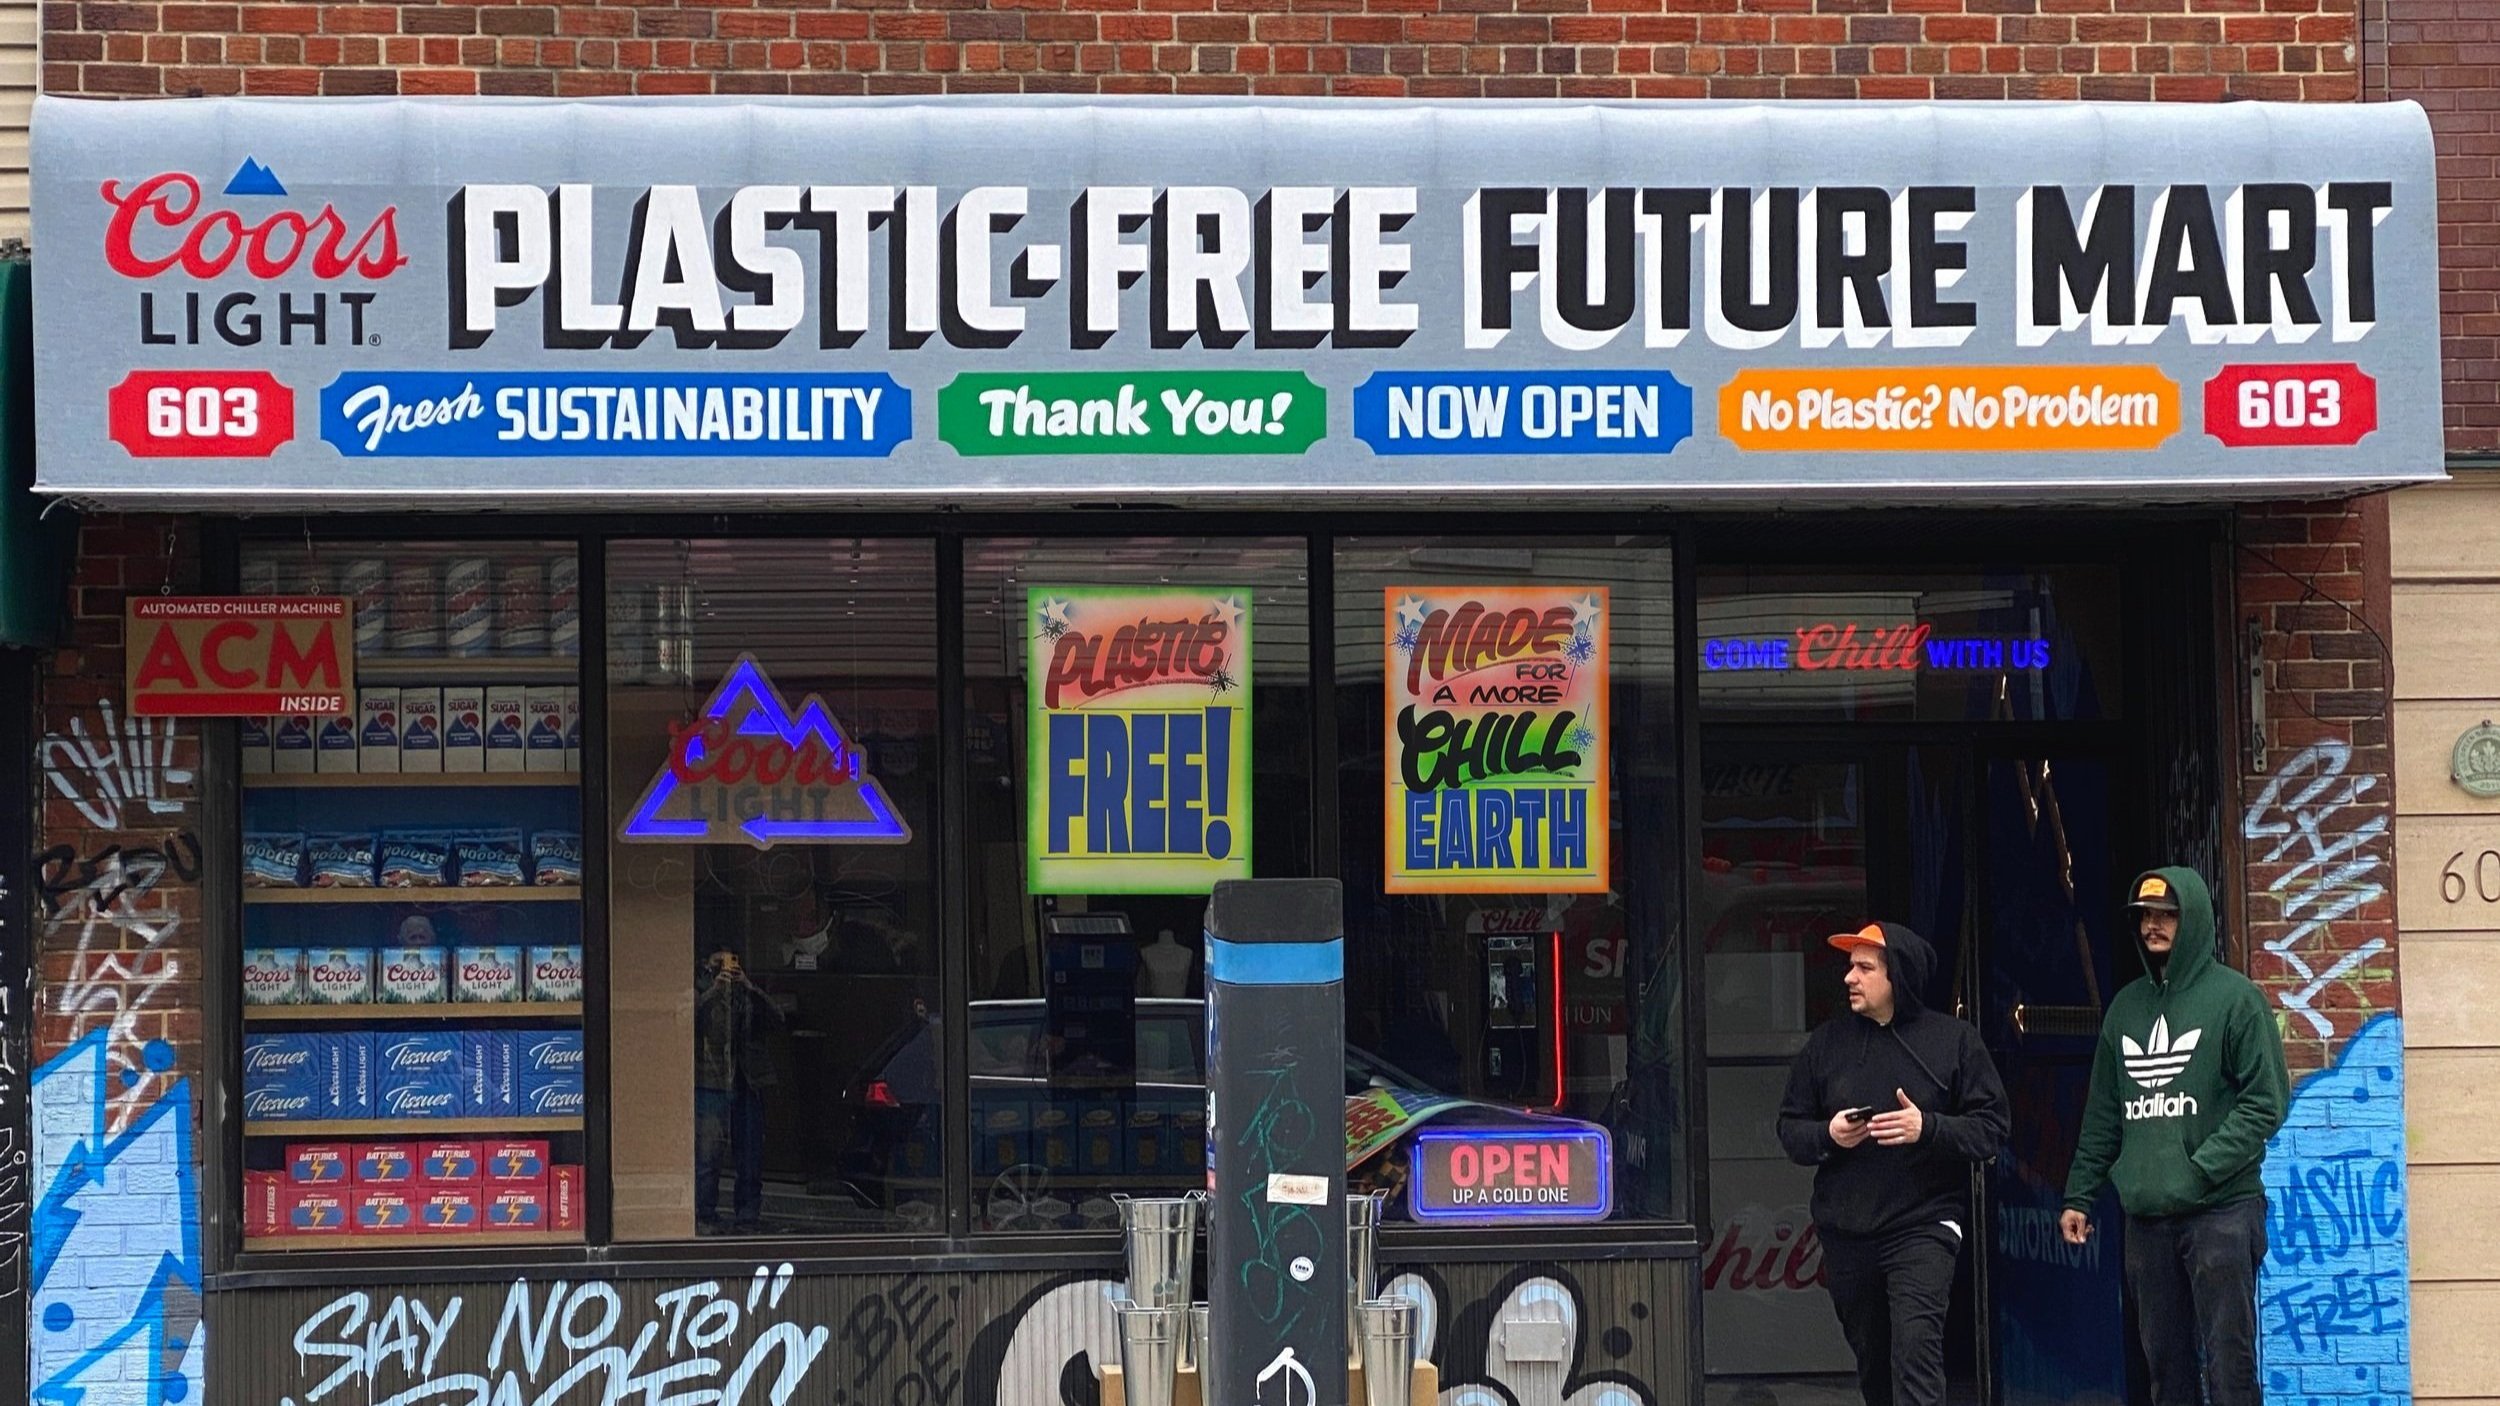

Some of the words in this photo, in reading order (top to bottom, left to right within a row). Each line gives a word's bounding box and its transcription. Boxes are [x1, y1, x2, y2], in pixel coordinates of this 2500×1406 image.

[101, 172, 408, 279] Coors
[1463, 186, 1977, 349] FUTURE
[2017, 181, 2392, 346] MART
[141, 292, 376, 346] LIGHT
[147, 387, 258, 437] 603
[343, 382, 484, 451] Fresh
[498, 387, 882, 441] SUSTAINABILITY
[979, 384, 1149, 437] Thank
[1161, 391, 1293, 436] You!
[1388, 384, 1510, 440] NOW
[1521, 386, 1658, 439] OPEN
[1741, 389, 1793, 432] No
[1798, 384, 1942, 431] Plastic?
[1949, 388, 1998, 429] No
[2004, 385, 2158, 428] Problem
[2238, 380, 2341, 427] 603
[141, 603, 220, 614] AUTOMATED
[224, 603, 277, 614] CHILLER
[280, 603, 341, 614] MACHINE
[134, 620, 341, 688] ACM
[1407, 601, 1574, 696] MADE
[1704, 639, 1789, 671] COME
[1796, 623, 1931, 671] Chill
[1926, 639, 2002, 669] WITH
[2012, 639, 2050, 669] US
[1046, 615, 1228, 709] PLASTIC
[1516, 663, 1569, 680] FOR
[280, 696, 342, 711] INSIDE
[365, 702, 395, 711] SUGAR
[406, 703, 436, 714] SUGAR
[448, 701, 478, 711] SUGAR
[490, 703, 521, 713] SUGAR
[530, 704, 560, 714] SUGAR
[1433, 686, 1456, 703] A
[1470, 686, 1562, 703] MORE
[669, 714, 858, 785] Coors
[1397, 704, 1581, 793] CHILL
[1048, 706, 1232, 859] FREE!
[688, 786, 830, 821] LIGHT
[1405, 788, 1588, 870] EARTH
[534, 846, 581, 861] NOODL
[244, 964, 290, 982] Coors
[250, 982, 280, 991] LIGHT
[312, 964, 361, 982] Coors
[321, 982, 353, 991] LIGHT
[387, 964, 437, 981] Coors
[396, 981, 427, 990] LIGHT
[463, 964, 512, 981] Coors
[471, 981, 502, 990] LIGHT
[545, 980, 576, 988] LIGHT
[244, 1043, 309, 1072] Tissues
[385, 1042, 451, 1071] Tissues
[244, 1087, 309, 1117] Tissues
[385, 1085, 452, 1114] Tissues
[1450, 1144, 1569, 1187] OPEN
[1453, 1188, 1475, 1204] UP
[1478, 1188, 1488, 1203] A
[1493, 1187, 1533, 1203] COLD
[1538, 1187, 1569, 1202] ONE
[2265, 1149, 2402, 1266] LASTIC
[2262, 1269, 2405, 1353] FREE
[293, 1291, 462, 1400] SAY
[489, 1278, 621, 1375] NO
